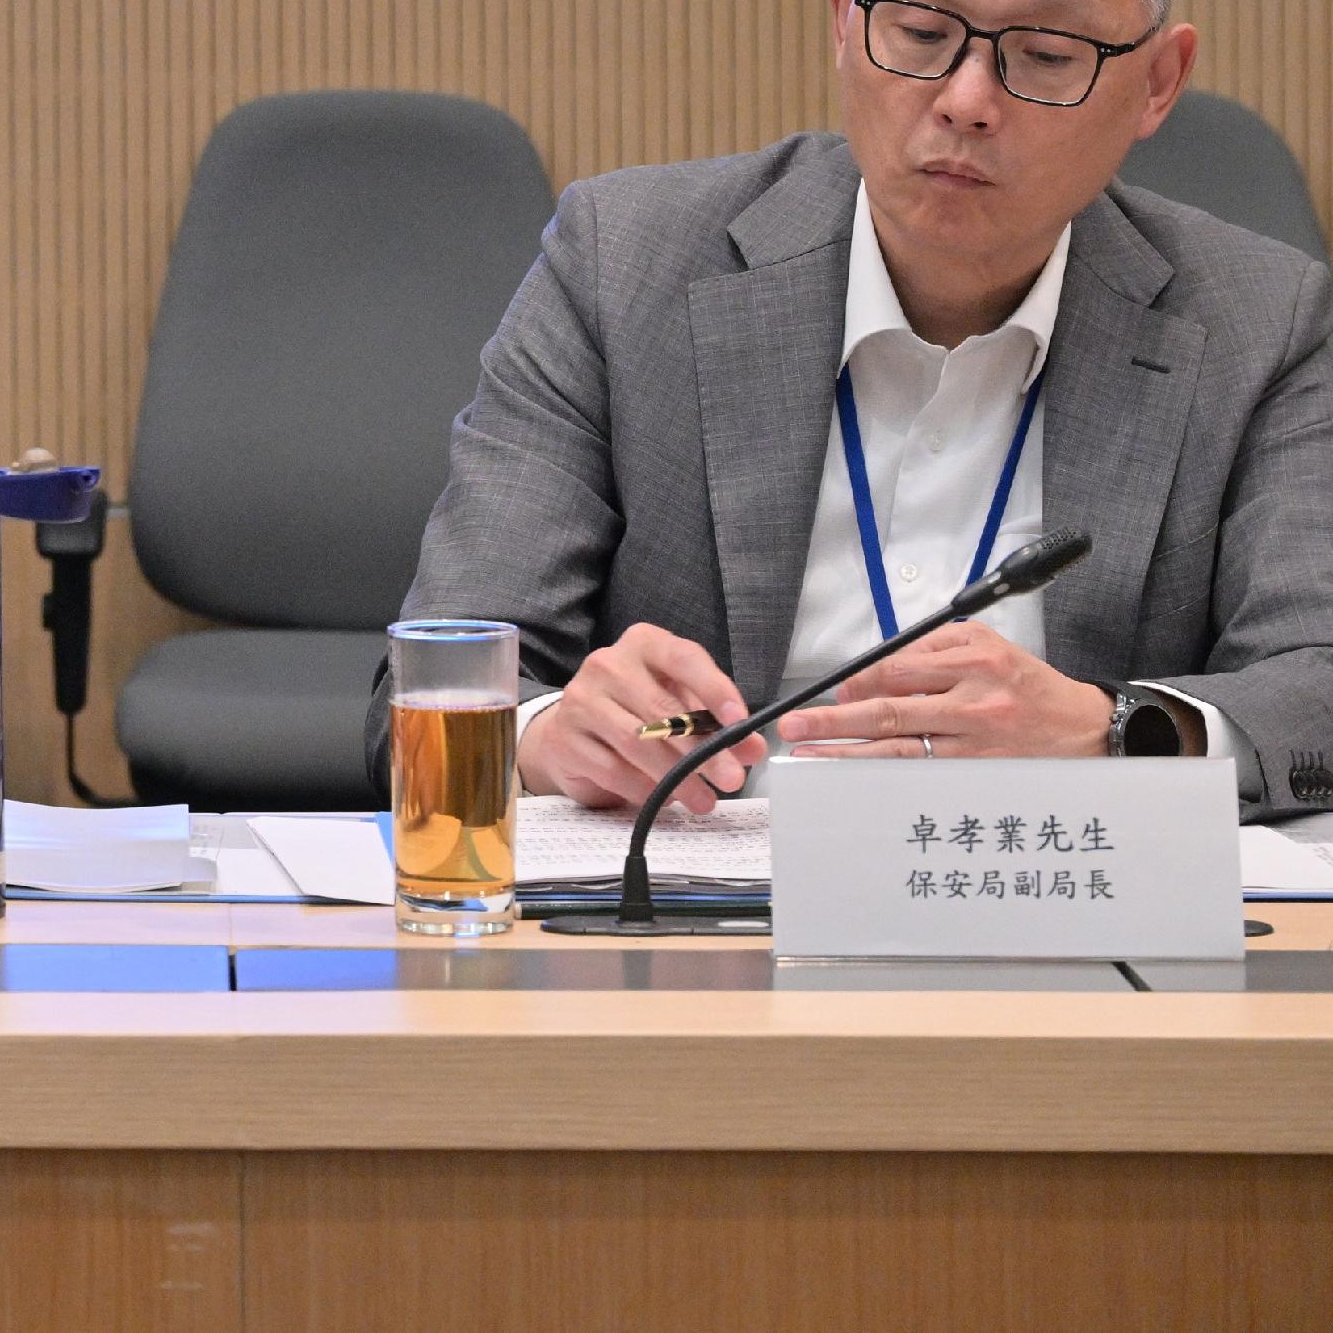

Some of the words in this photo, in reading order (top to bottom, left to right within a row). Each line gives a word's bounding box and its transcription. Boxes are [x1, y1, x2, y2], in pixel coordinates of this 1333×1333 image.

[906, 814, 1116, 854] 卓孝業先生
[905, 869, 1116, 900] 保安局副局長
